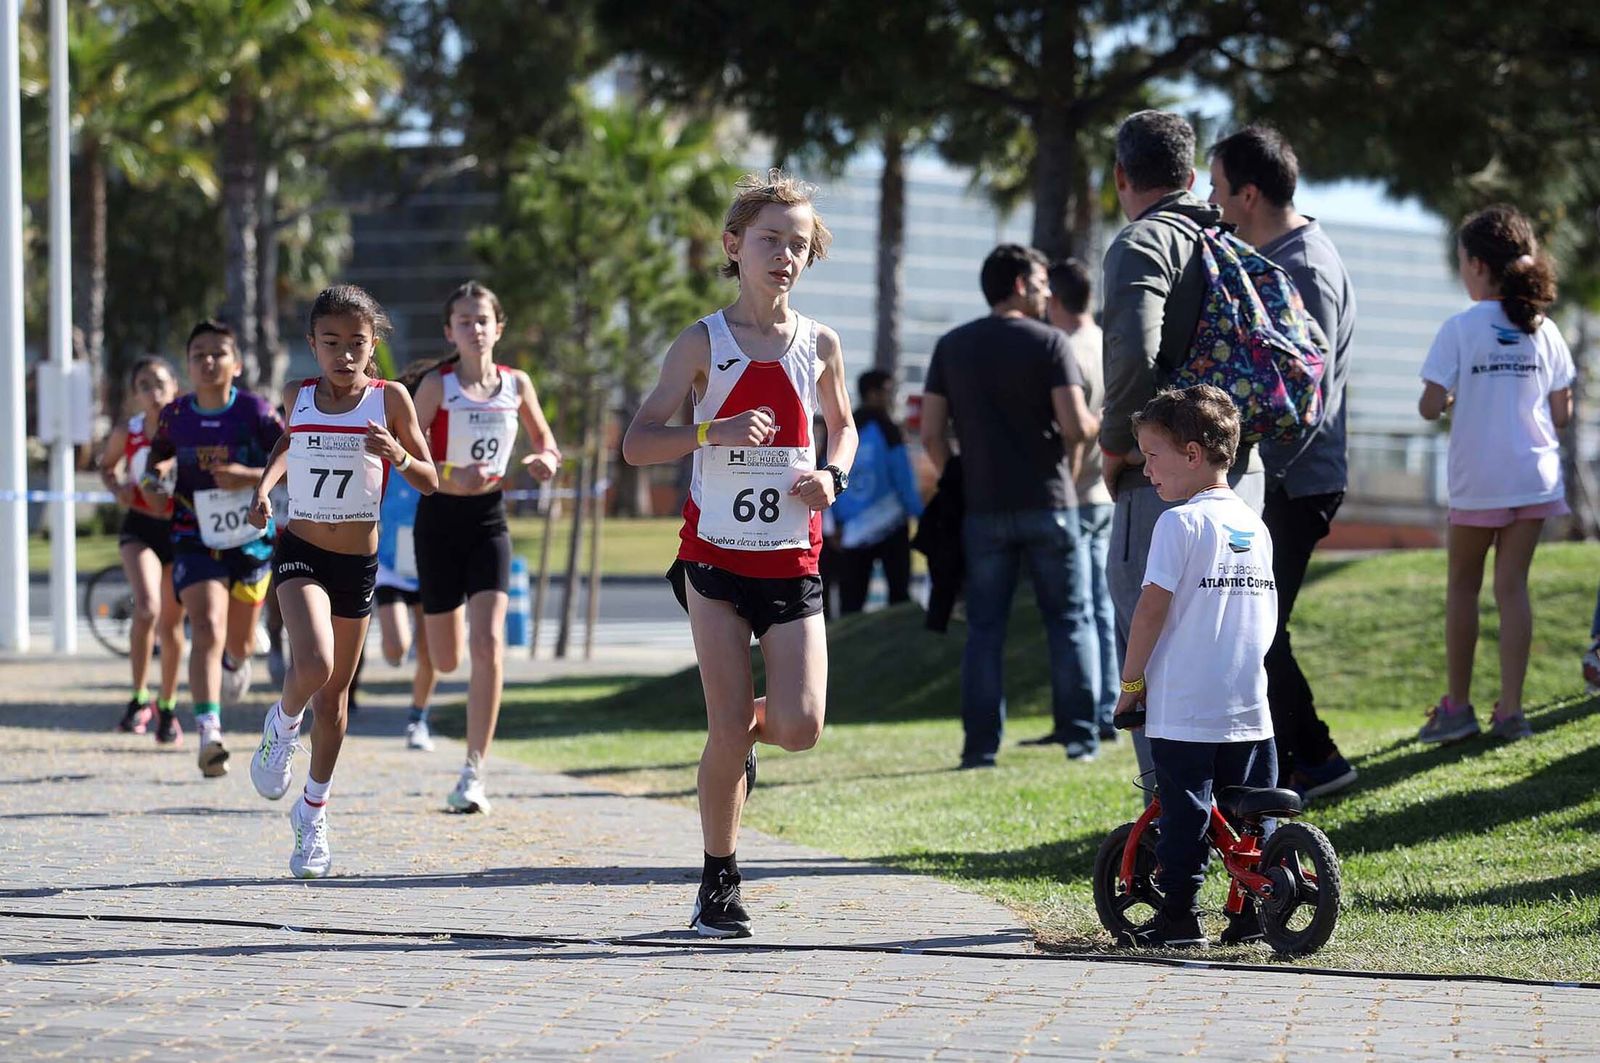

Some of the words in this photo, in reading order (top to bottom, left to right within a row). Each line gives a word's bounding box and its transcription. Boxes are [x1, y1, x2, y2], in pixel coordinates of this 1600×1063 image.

[471, 438, 499, 460] 69
[309, 467, 353, 499] 77
[733, 488, 780, 523] 68
[706, 535, 735, 546] Huelva
[759, 539, 770, 547] tus
[1198, 577, 1245, 588] ATLANTIC
[1247, 576, 1275, 590] COPPE
